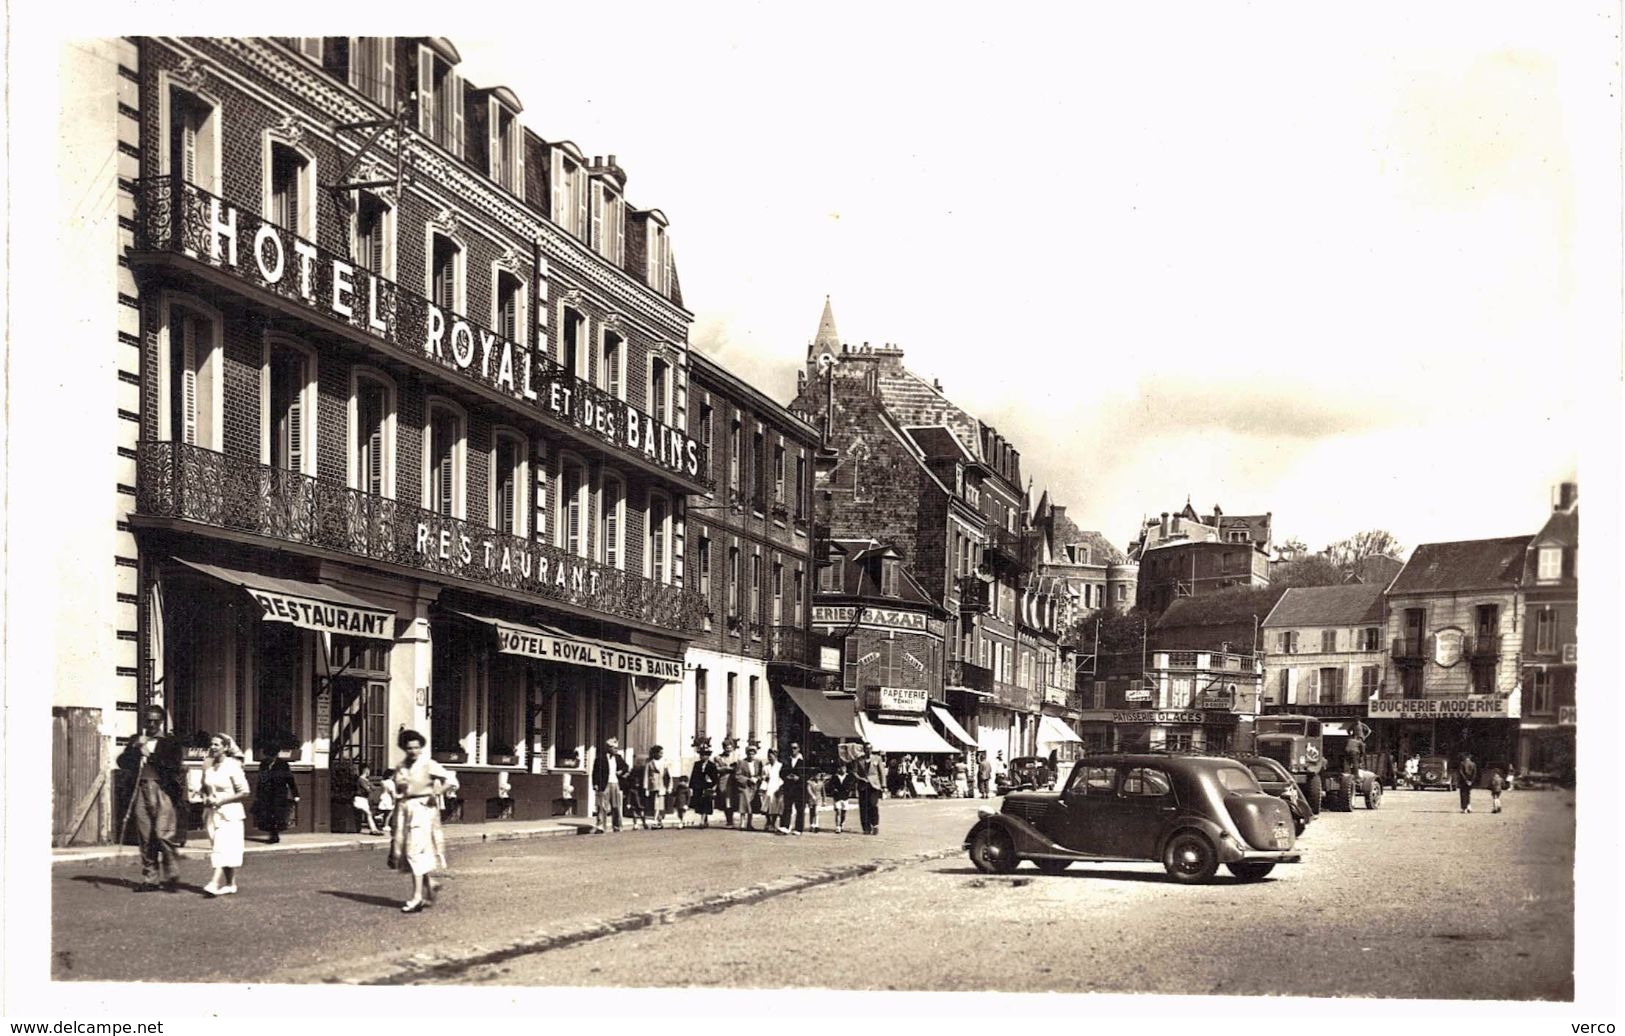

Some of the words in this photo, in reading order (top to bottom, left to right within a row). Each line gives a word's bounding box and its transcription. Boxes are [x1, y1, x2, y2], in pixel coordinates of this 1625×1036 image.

[211, 198, 386, 332] HOTEL
[428, 305, 537, 400] ROYAL
[551, 382, 570, 415] ET
[584, 399, 615, 437] DES
[627, 406, 698, 477] BAINS
[416, 523, 600, 595] RESTAURANT
[812, 608, 854, 621] ERIES
[863, 610, 924, 628] BAZAR
[553, 641, 596, 662] ROYAL
[601, 652, 614, 666] ET
[618, 656, 642, 672] DES
[646, 660, 680, 677] BAINS
[883, 689, 926, 699] PAPETERIE
[1371, 700, 1437, 712] BOUCHERIE
[1440, 700, 1503, 712] MODERNE
[1113, 712, 1154, 722] PATISSERIE
[1158, 712, 1202, 722] GLACES
